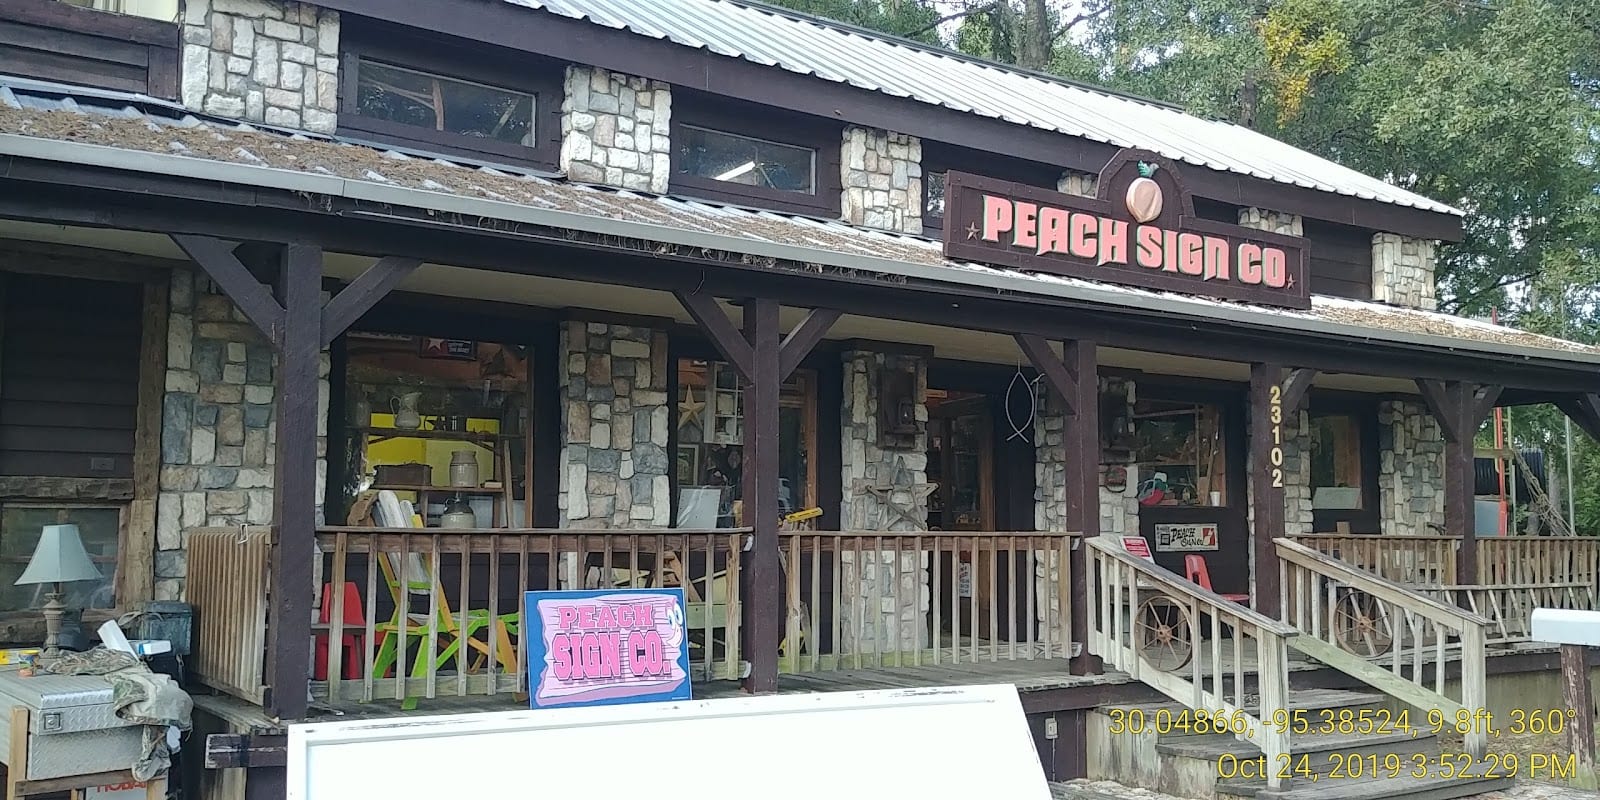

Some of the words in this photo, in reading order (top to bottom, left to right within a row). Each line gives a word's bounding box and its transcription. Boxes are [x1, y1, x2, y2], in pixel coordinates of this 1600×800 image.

[982, 194, 1129, 266] PEACH
[1136, 225, 1230, 281] SIGN
[1237, 242, 1287, 288] CO
[1269, 385, 1283, 488] 23102
[558, 604, 654, 630] PEACH
[552, 631, 622, 681] SIGN
[627, 630, 672, 676] CO.
